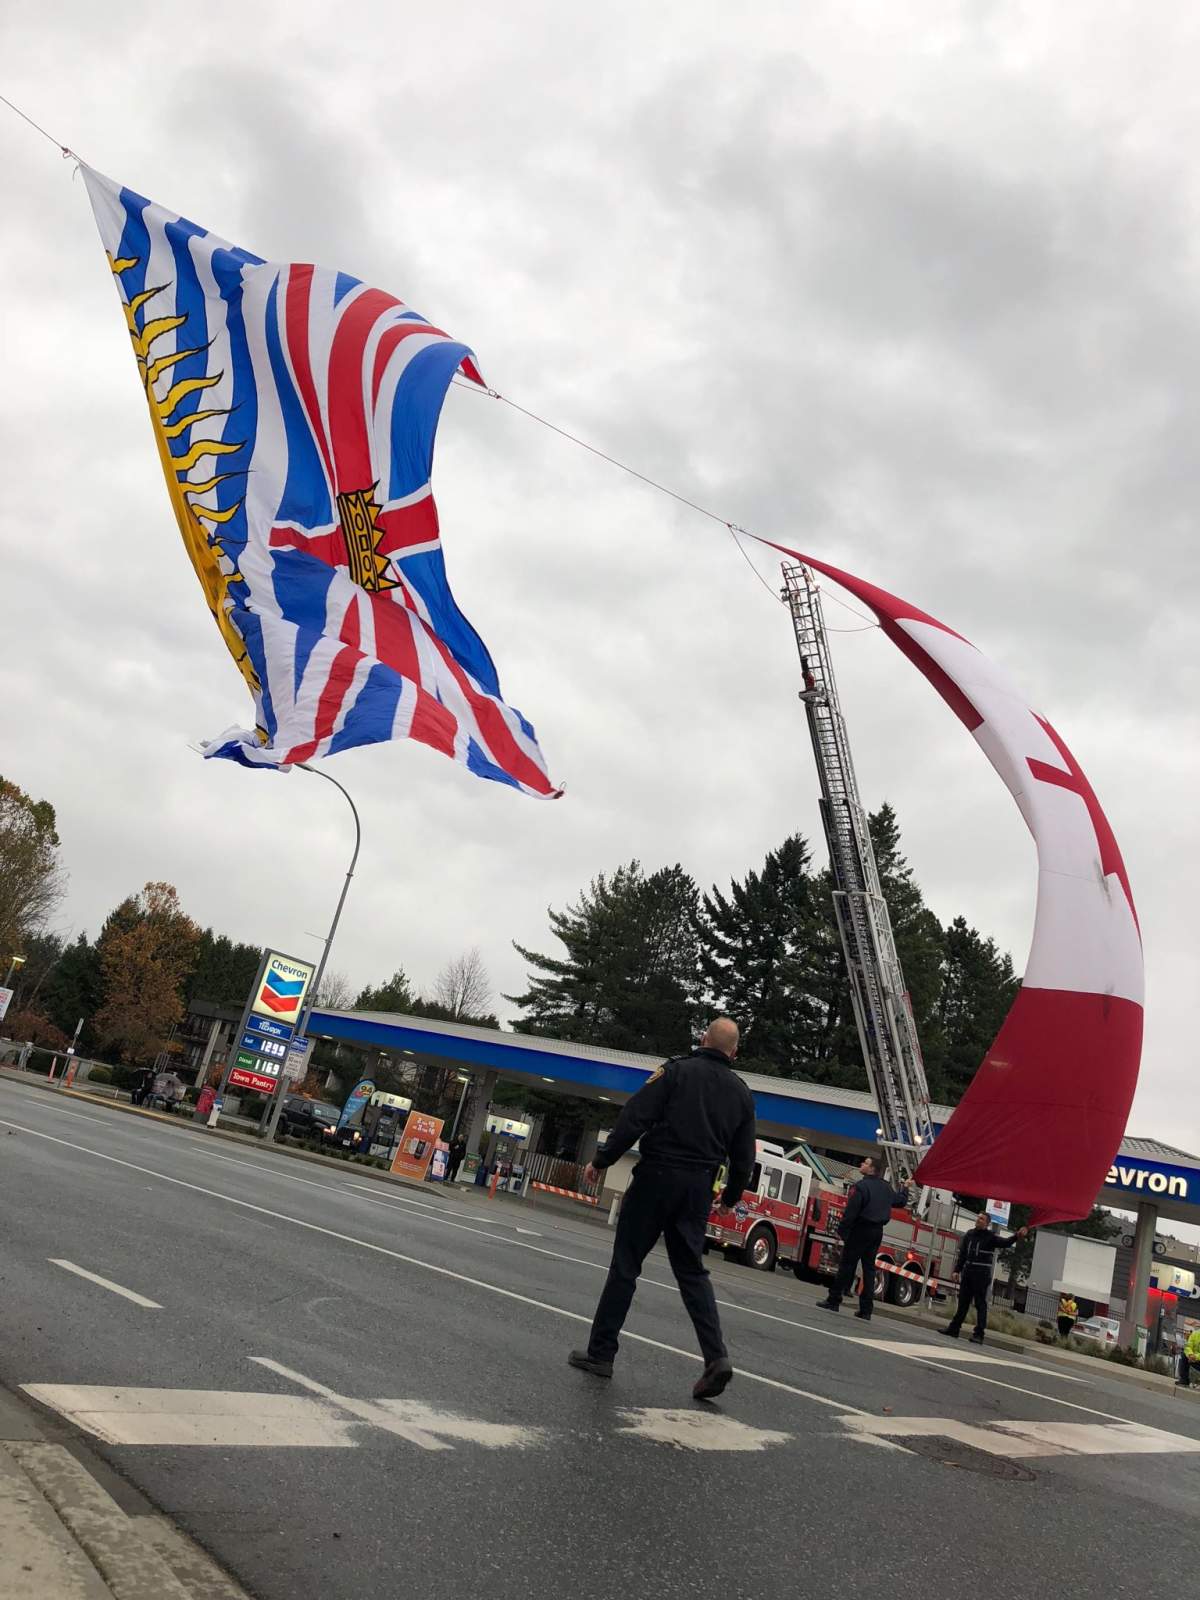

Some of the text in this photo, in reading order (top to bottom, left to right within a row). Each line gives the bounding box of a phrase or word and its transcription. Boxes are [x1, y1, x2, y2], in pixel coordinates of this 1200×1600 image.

[271, 959, 308, 979] Chevron
[238, 1056, 253, 1065] Diesel
[233, 1071, 274, 1091] Town Pantry
[1104, 1164, 1188, 1198] evron
